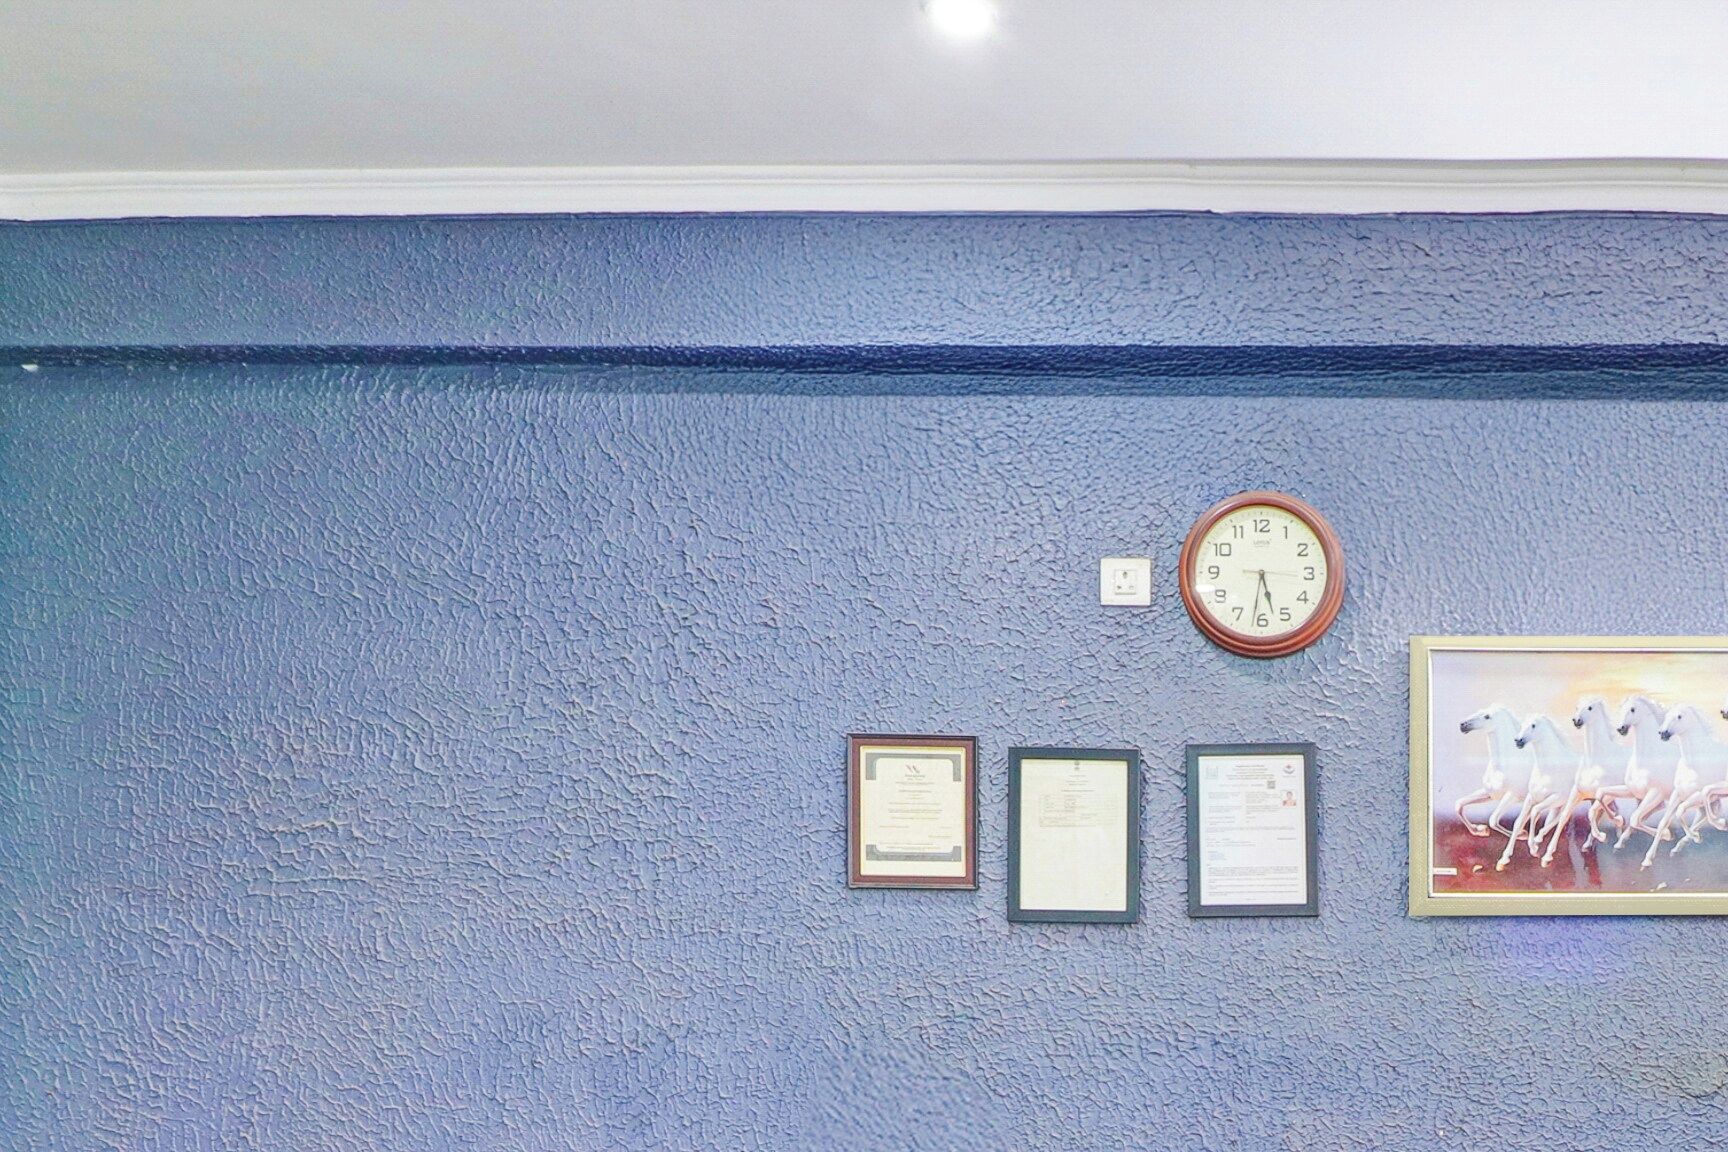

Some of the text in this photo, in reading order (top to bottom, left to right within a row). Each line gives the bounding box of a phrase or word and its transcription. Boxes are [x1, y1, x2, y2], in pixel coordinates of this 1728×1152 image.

[1232, 525, 1244, 539] 11
[1253, 519, 1271, 533] 12
[1283, 525, 1288, 539] 1
[1213, 542, 1232, 557] 10
[1297, 543, 1309, 557] 2
[1208, 565, 1220, 579] 9
[1303, 567, 1315, 581] 3
[1214, 589, 1227, 604] 8
[1296, 590, 1309, 604] 4
[1232, 607, 1244, 621] 7
[1257, 613, 1269, 627] 6
[1279, 607, 1291, 621] 5
